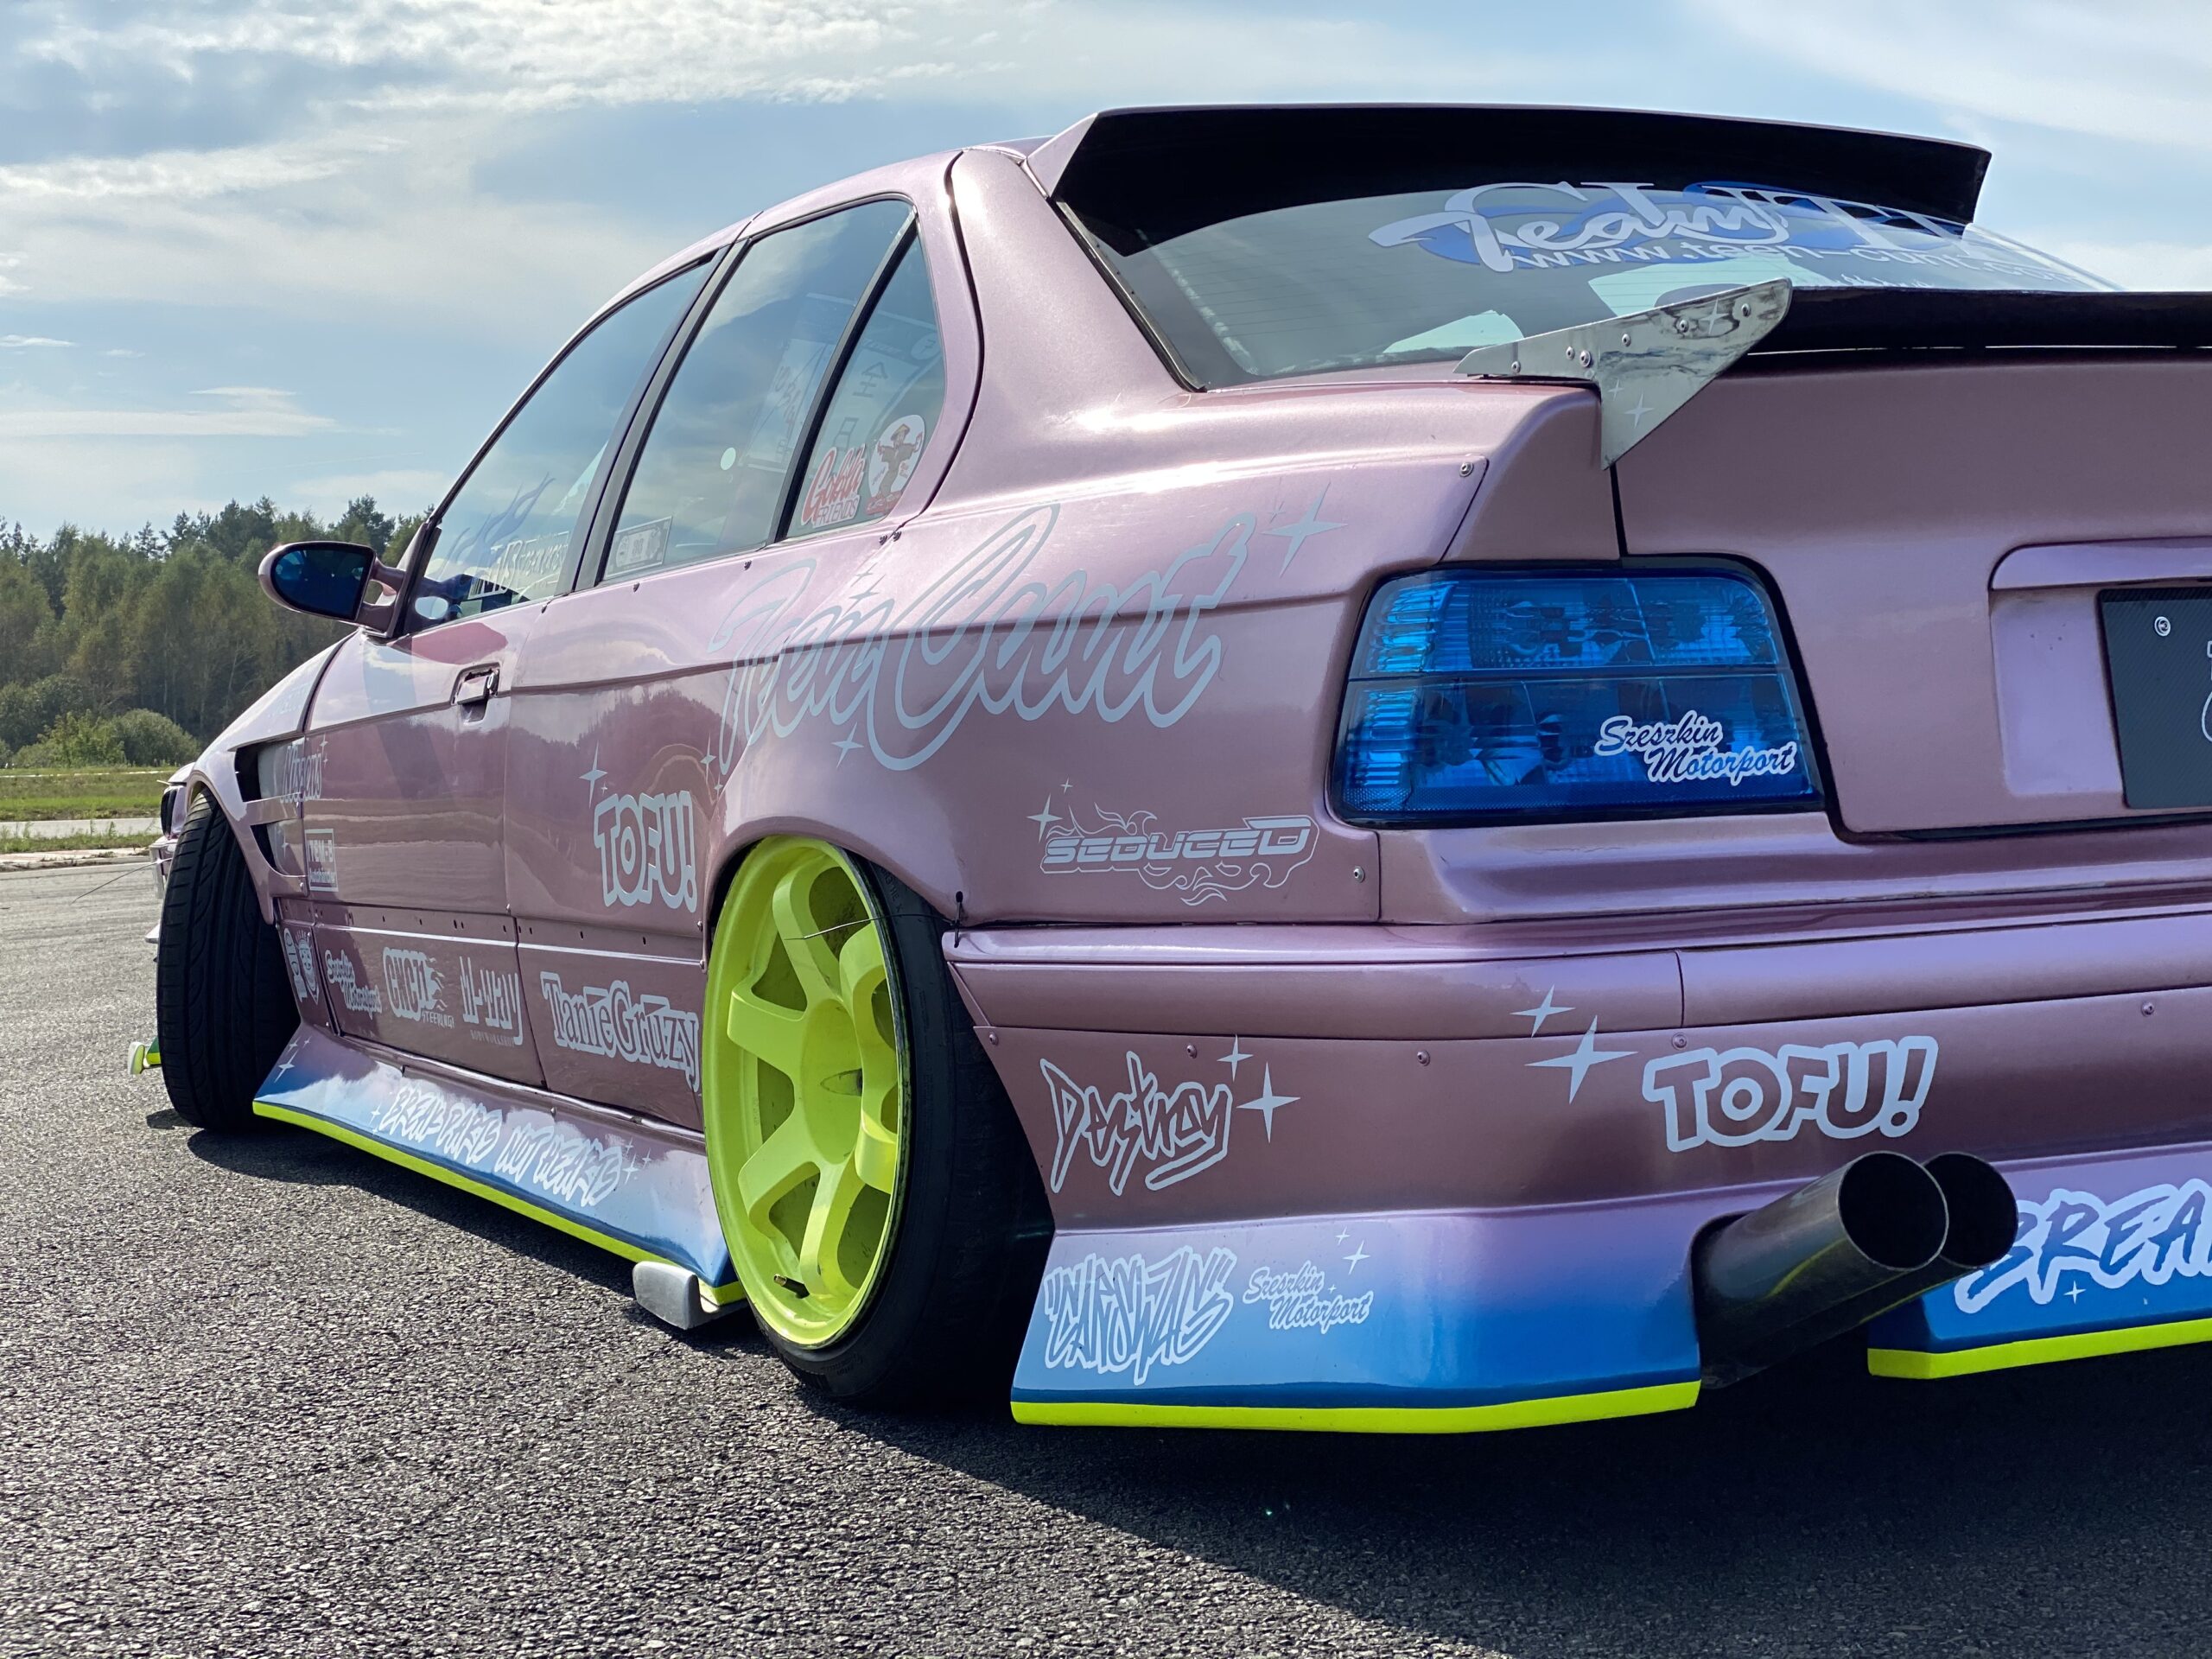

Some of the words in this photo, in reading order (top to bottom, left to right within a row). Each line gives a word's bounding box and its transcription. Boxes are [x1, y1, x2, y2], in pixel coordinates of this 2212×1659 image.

[817, 498, 859, 524] FRIENDS
[1594, 710, 1723, 756] Szeszkin
[1644, 741, 1797, 786] Motorport
[594, 791, 697, 912] TOFU!
[1043, 817, 1313, 866] SEDUCED
[540, 971, 700, 1093] TanieGruzy
[1643, 1036, 1939, 1152] TOFU!
[1954, 1178, 2212, 1314] BREA
[1243, 1260, 1325, 1304] Szeszkin
[1269, 1291, 1374, 1335] Motorport
